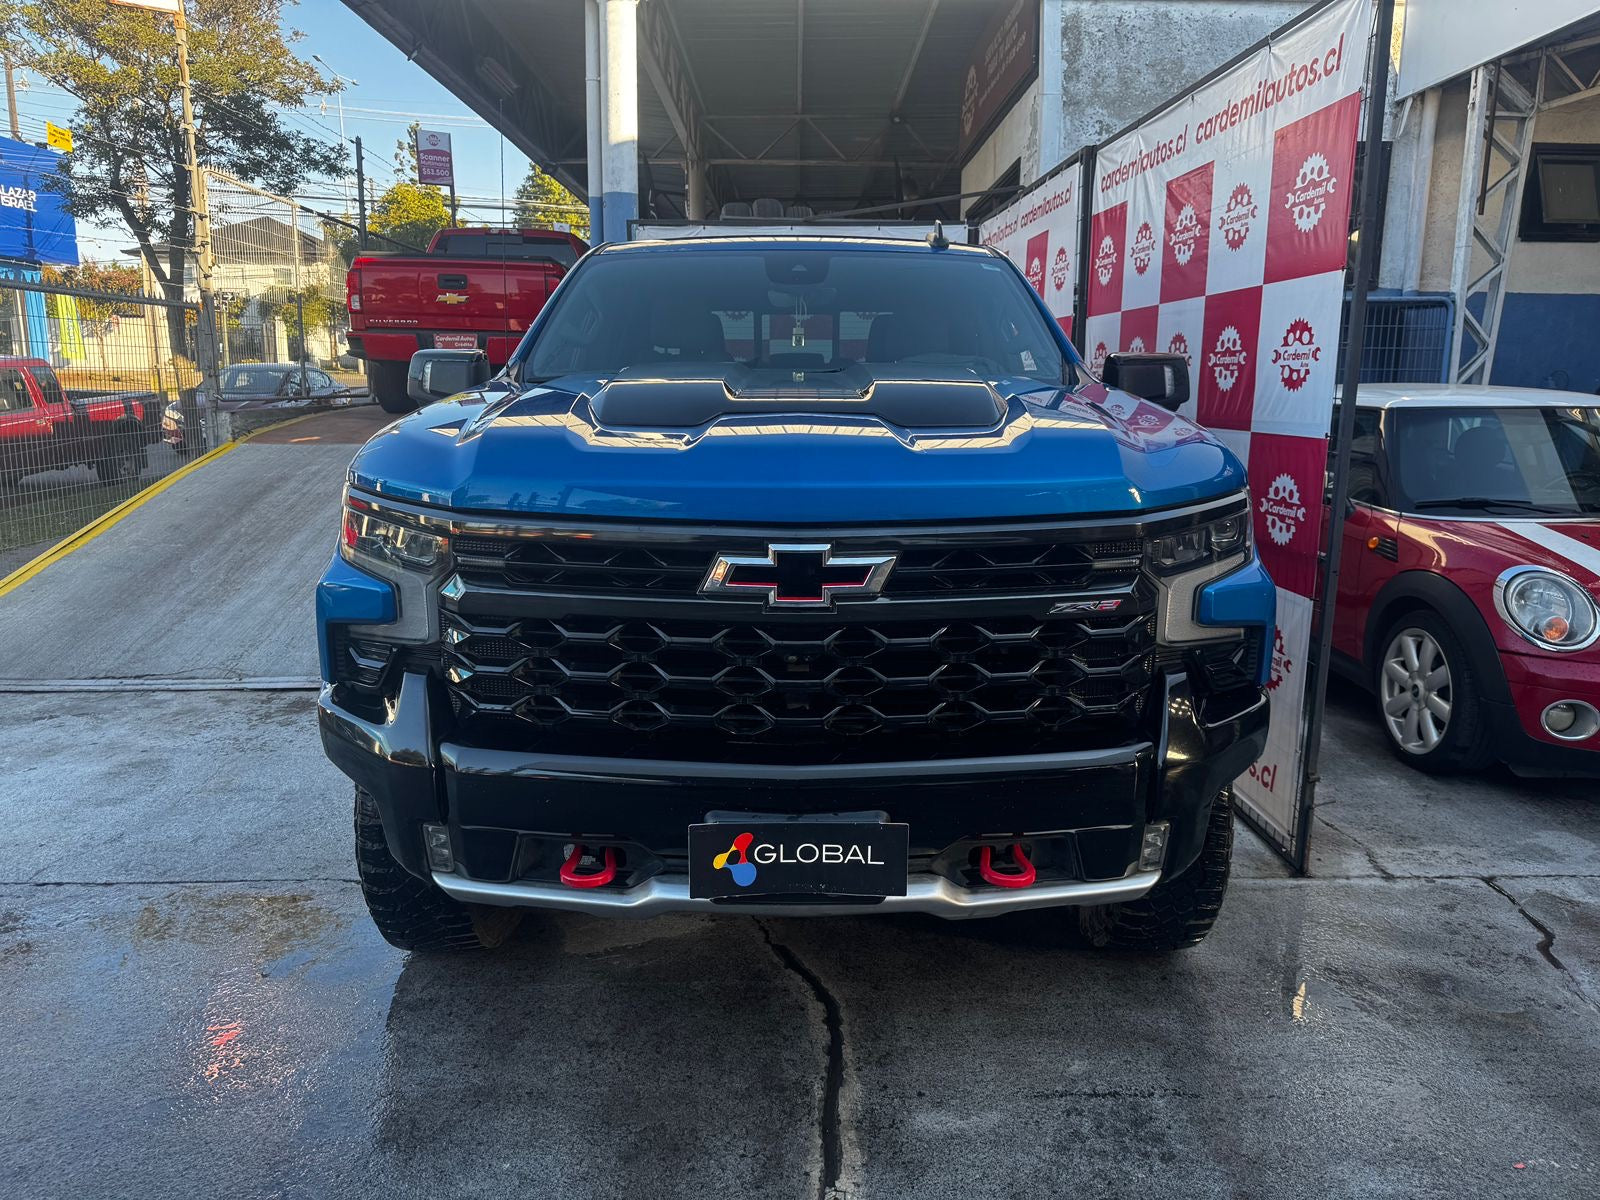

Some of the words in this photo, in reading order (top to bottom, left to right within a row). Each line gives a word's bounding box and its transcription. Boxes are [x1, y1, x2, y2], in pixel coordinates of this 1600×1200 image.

[1195, 32, 1345, 145] cardemilautos.cl
[420, 153, 450, 162] Scanner
[1101, 124, 1188, 194] cardemilautos.cl
[1295, 181, 1327, 203] Cardemil
[1216, 353, 1239, 364] Cardemil
[1282, 348, 1312, 361] Cardemil
[1268, 501, 1298, 518] Cardemil
[753, 843, 885, 865] GLOBAL
